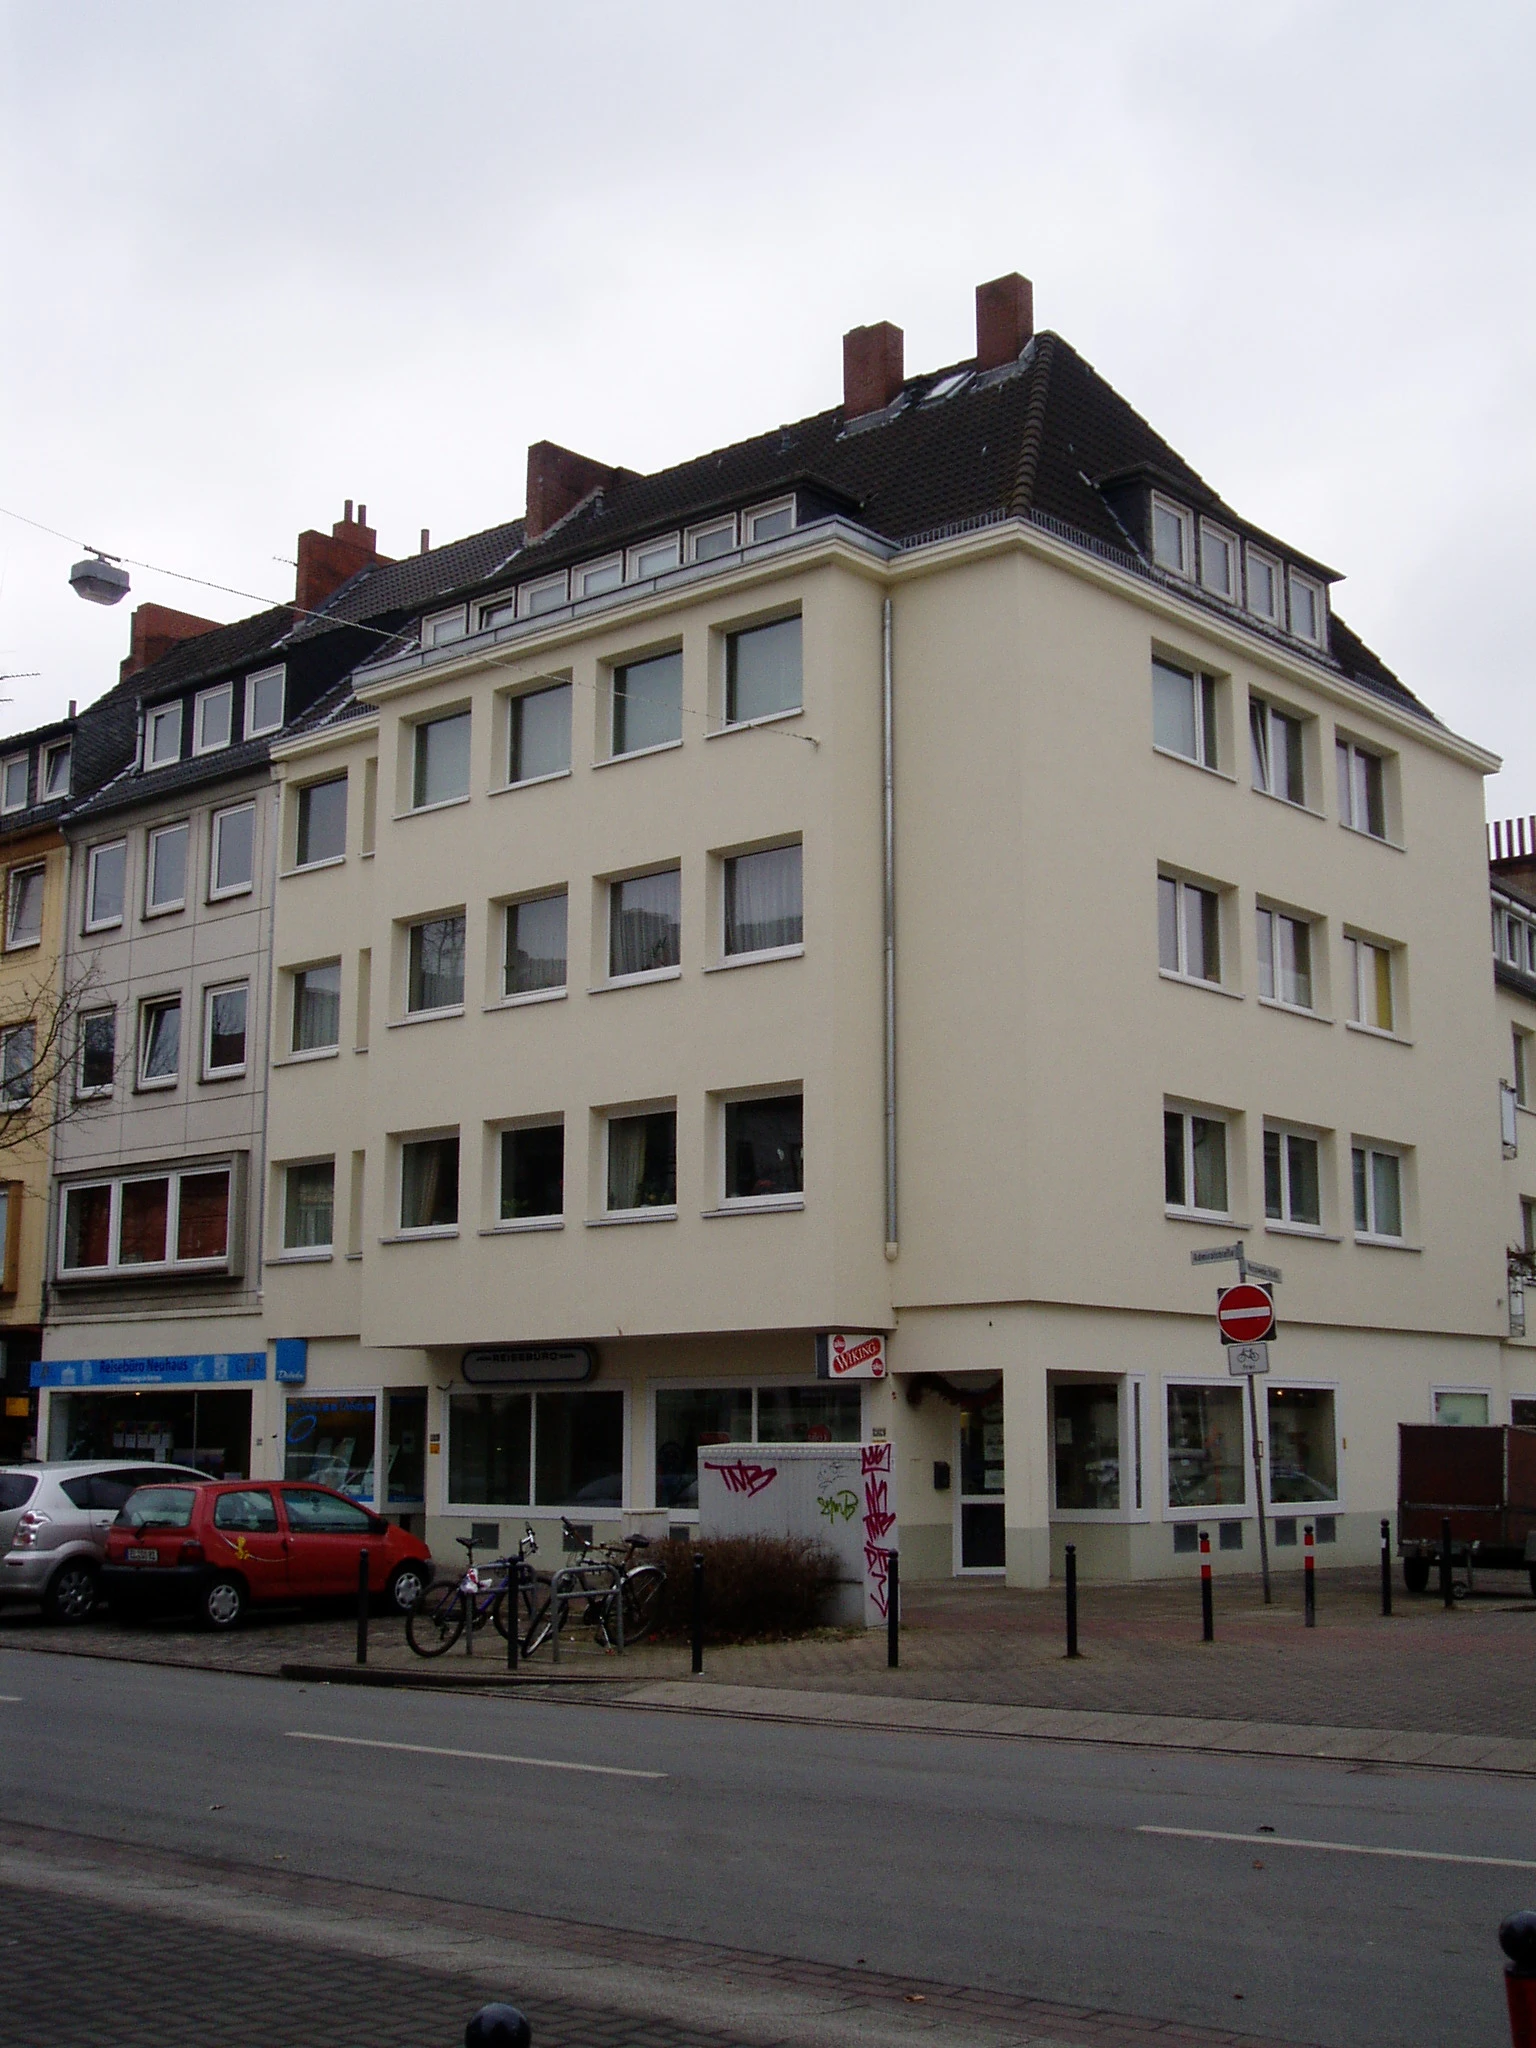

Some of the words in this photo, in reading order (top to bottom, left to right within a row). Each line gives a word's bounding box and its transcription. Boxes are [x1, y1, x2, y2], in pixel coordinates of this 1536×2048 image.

[100, 1358, 146, 1374] Reisebüro
[147, 1356, 188, 1372] Neuhaus
[836, 1342, 877, 1371] WIKING
